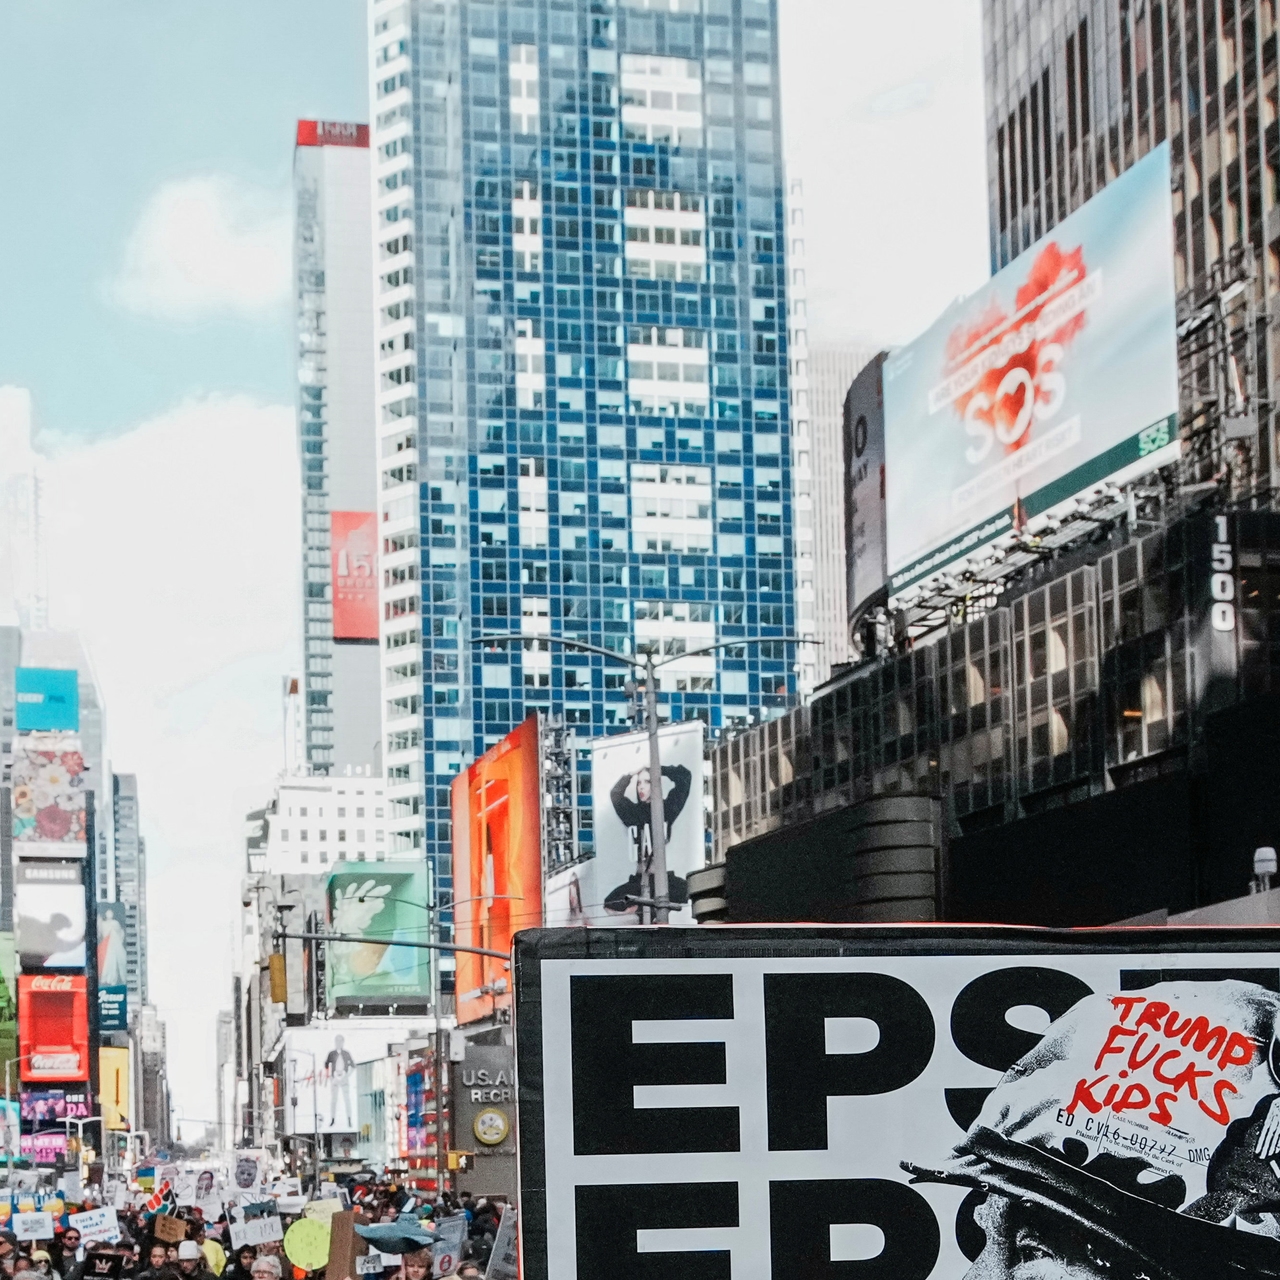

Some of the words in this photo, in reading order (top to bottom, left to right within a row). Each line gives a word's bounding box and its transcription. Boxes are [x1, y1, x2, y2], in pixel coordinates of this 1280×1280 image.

[1211, 515, 1236, 631] 1500
[25, 869, 76, 879] SAMSUNG
[1111, 996, 1257, 1071] TRUMP
[1094, 1025, 1238, 1126] FUCKS
[1056, 1108, 1075, 1127] ED
[1188, 1147, 1211, 1163] DMG
[1075, 1129, 1100, 1143] Plaintiff
[1113, 1115, 1126, 1125] CASE
[1127, 1119, 1150, 1132] NUMBER
